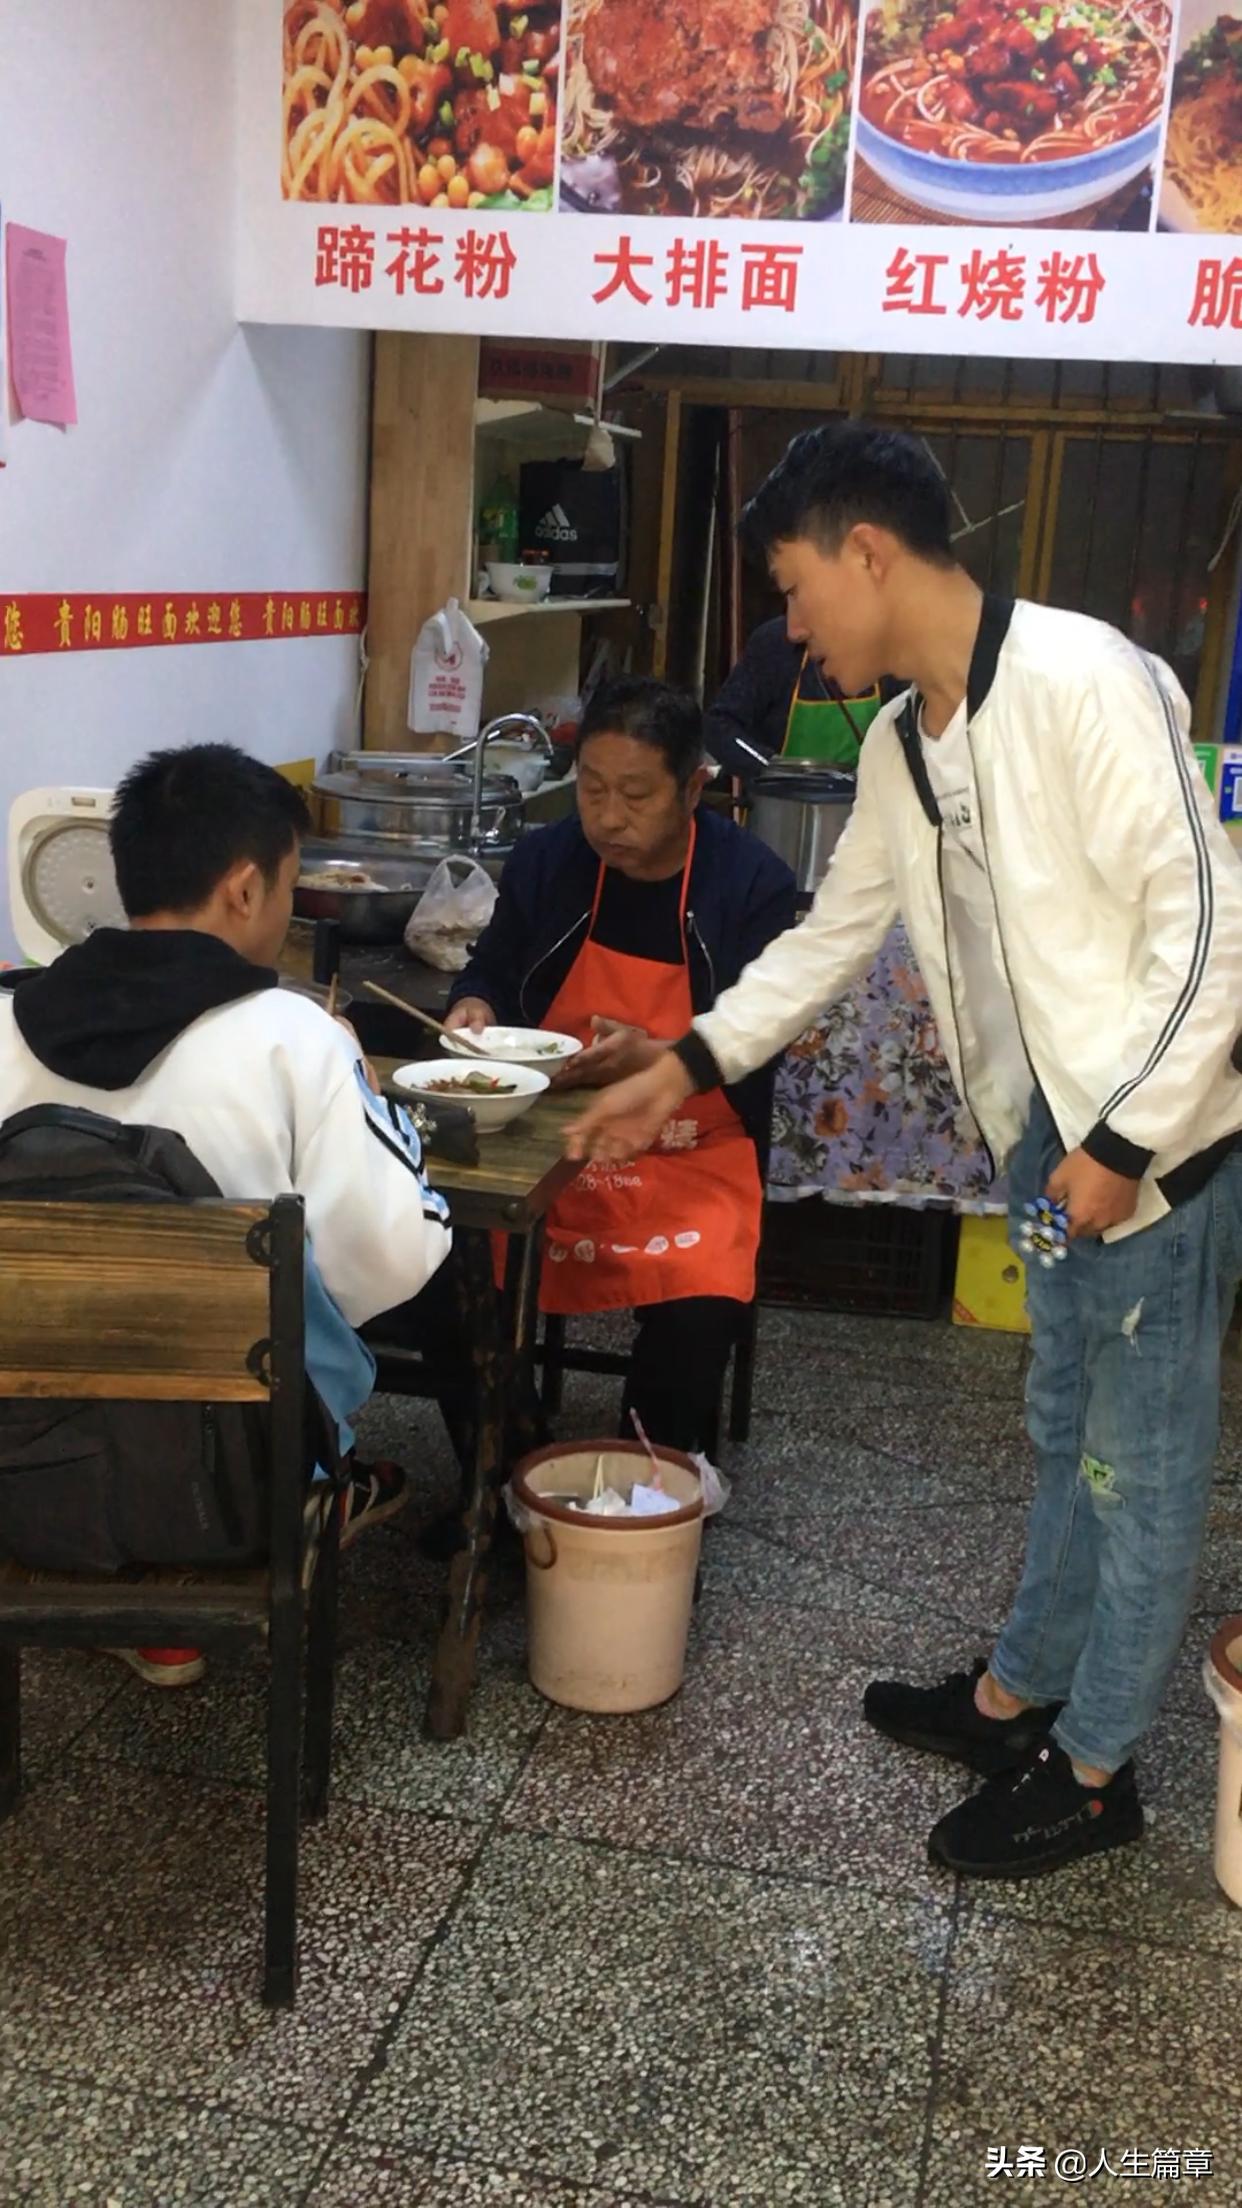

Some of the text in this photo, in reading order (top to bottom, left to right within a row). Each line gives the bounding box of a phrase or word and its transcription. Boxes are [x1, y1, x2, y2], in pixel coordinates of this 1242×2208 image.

[314, 224, 518, 299] 蹄花粉
[592, 236, 804, 311] 大排面
[882, 247, 1106, 323] 红烧粉
[535, 525, 578, 541] adas
